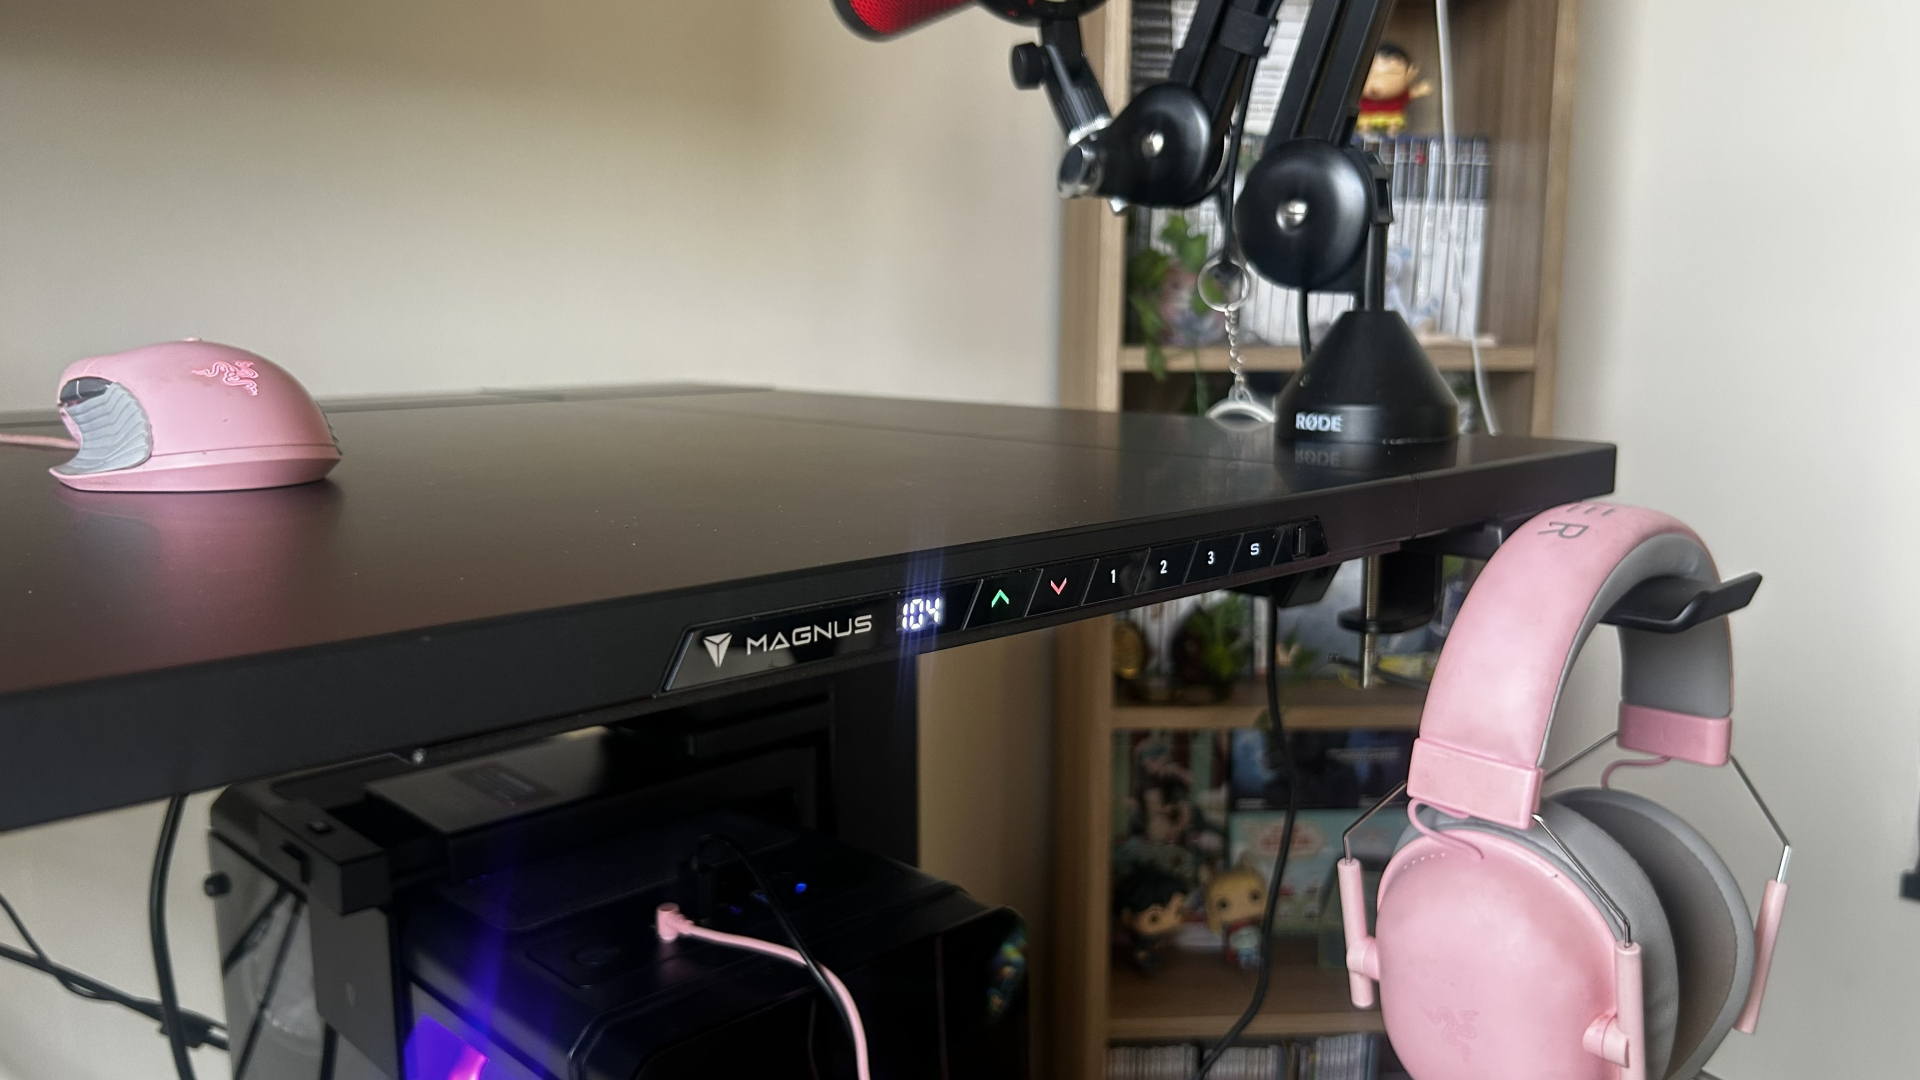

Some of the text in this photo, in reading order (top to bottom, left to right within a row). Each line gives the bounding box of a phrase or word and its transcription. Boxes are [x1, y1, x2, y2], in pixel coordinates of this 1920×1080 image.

[1296, 412, 1342, 432] RØDE
[1110, 543, 1260, 584] 1 2 3 S
[901, 598, 941, 630] 104
[746, 614, 873, 656] MAGNUS
